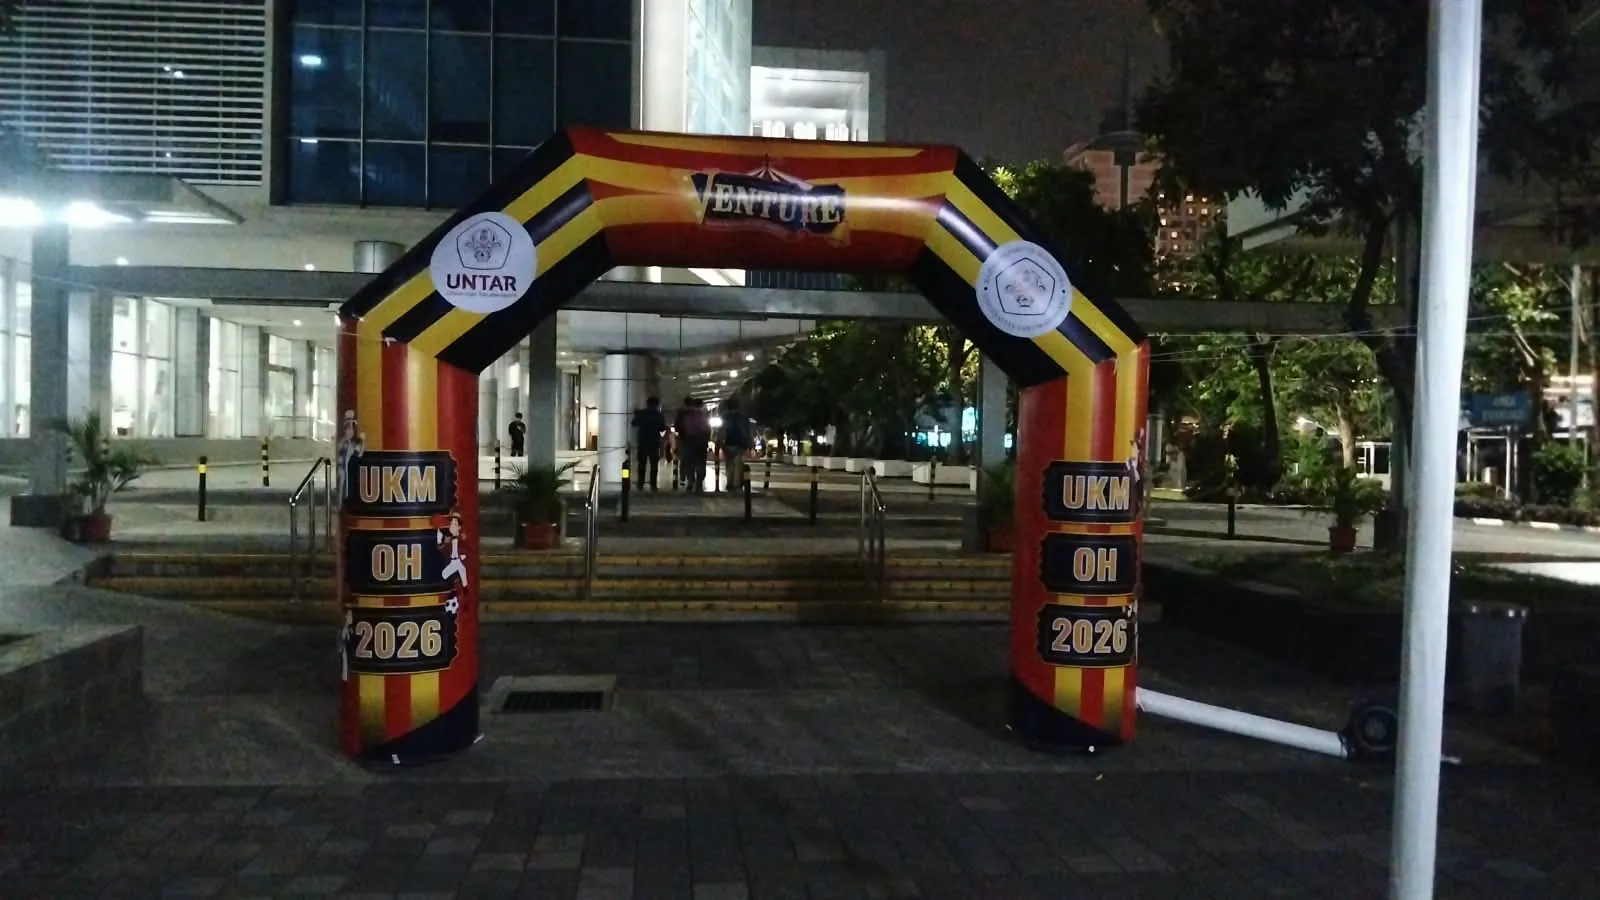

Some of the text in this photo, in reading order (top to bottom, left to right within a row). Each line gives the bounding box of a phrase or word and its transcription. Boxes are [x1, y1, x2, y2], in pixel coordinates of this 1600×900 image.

[681, 170, 841, 225] VENTURE
[446, 273, 517, 292] UNTAR
[359, 465, 437, 503] UKM
[1062, 474, 1130, 511] UKM
[371, 543, 422, 581] OH
[1072, 547, 1118, 582] OH
[355, 619, 442, 660] 2026
[1051, 617, 1128, 654] 2026
